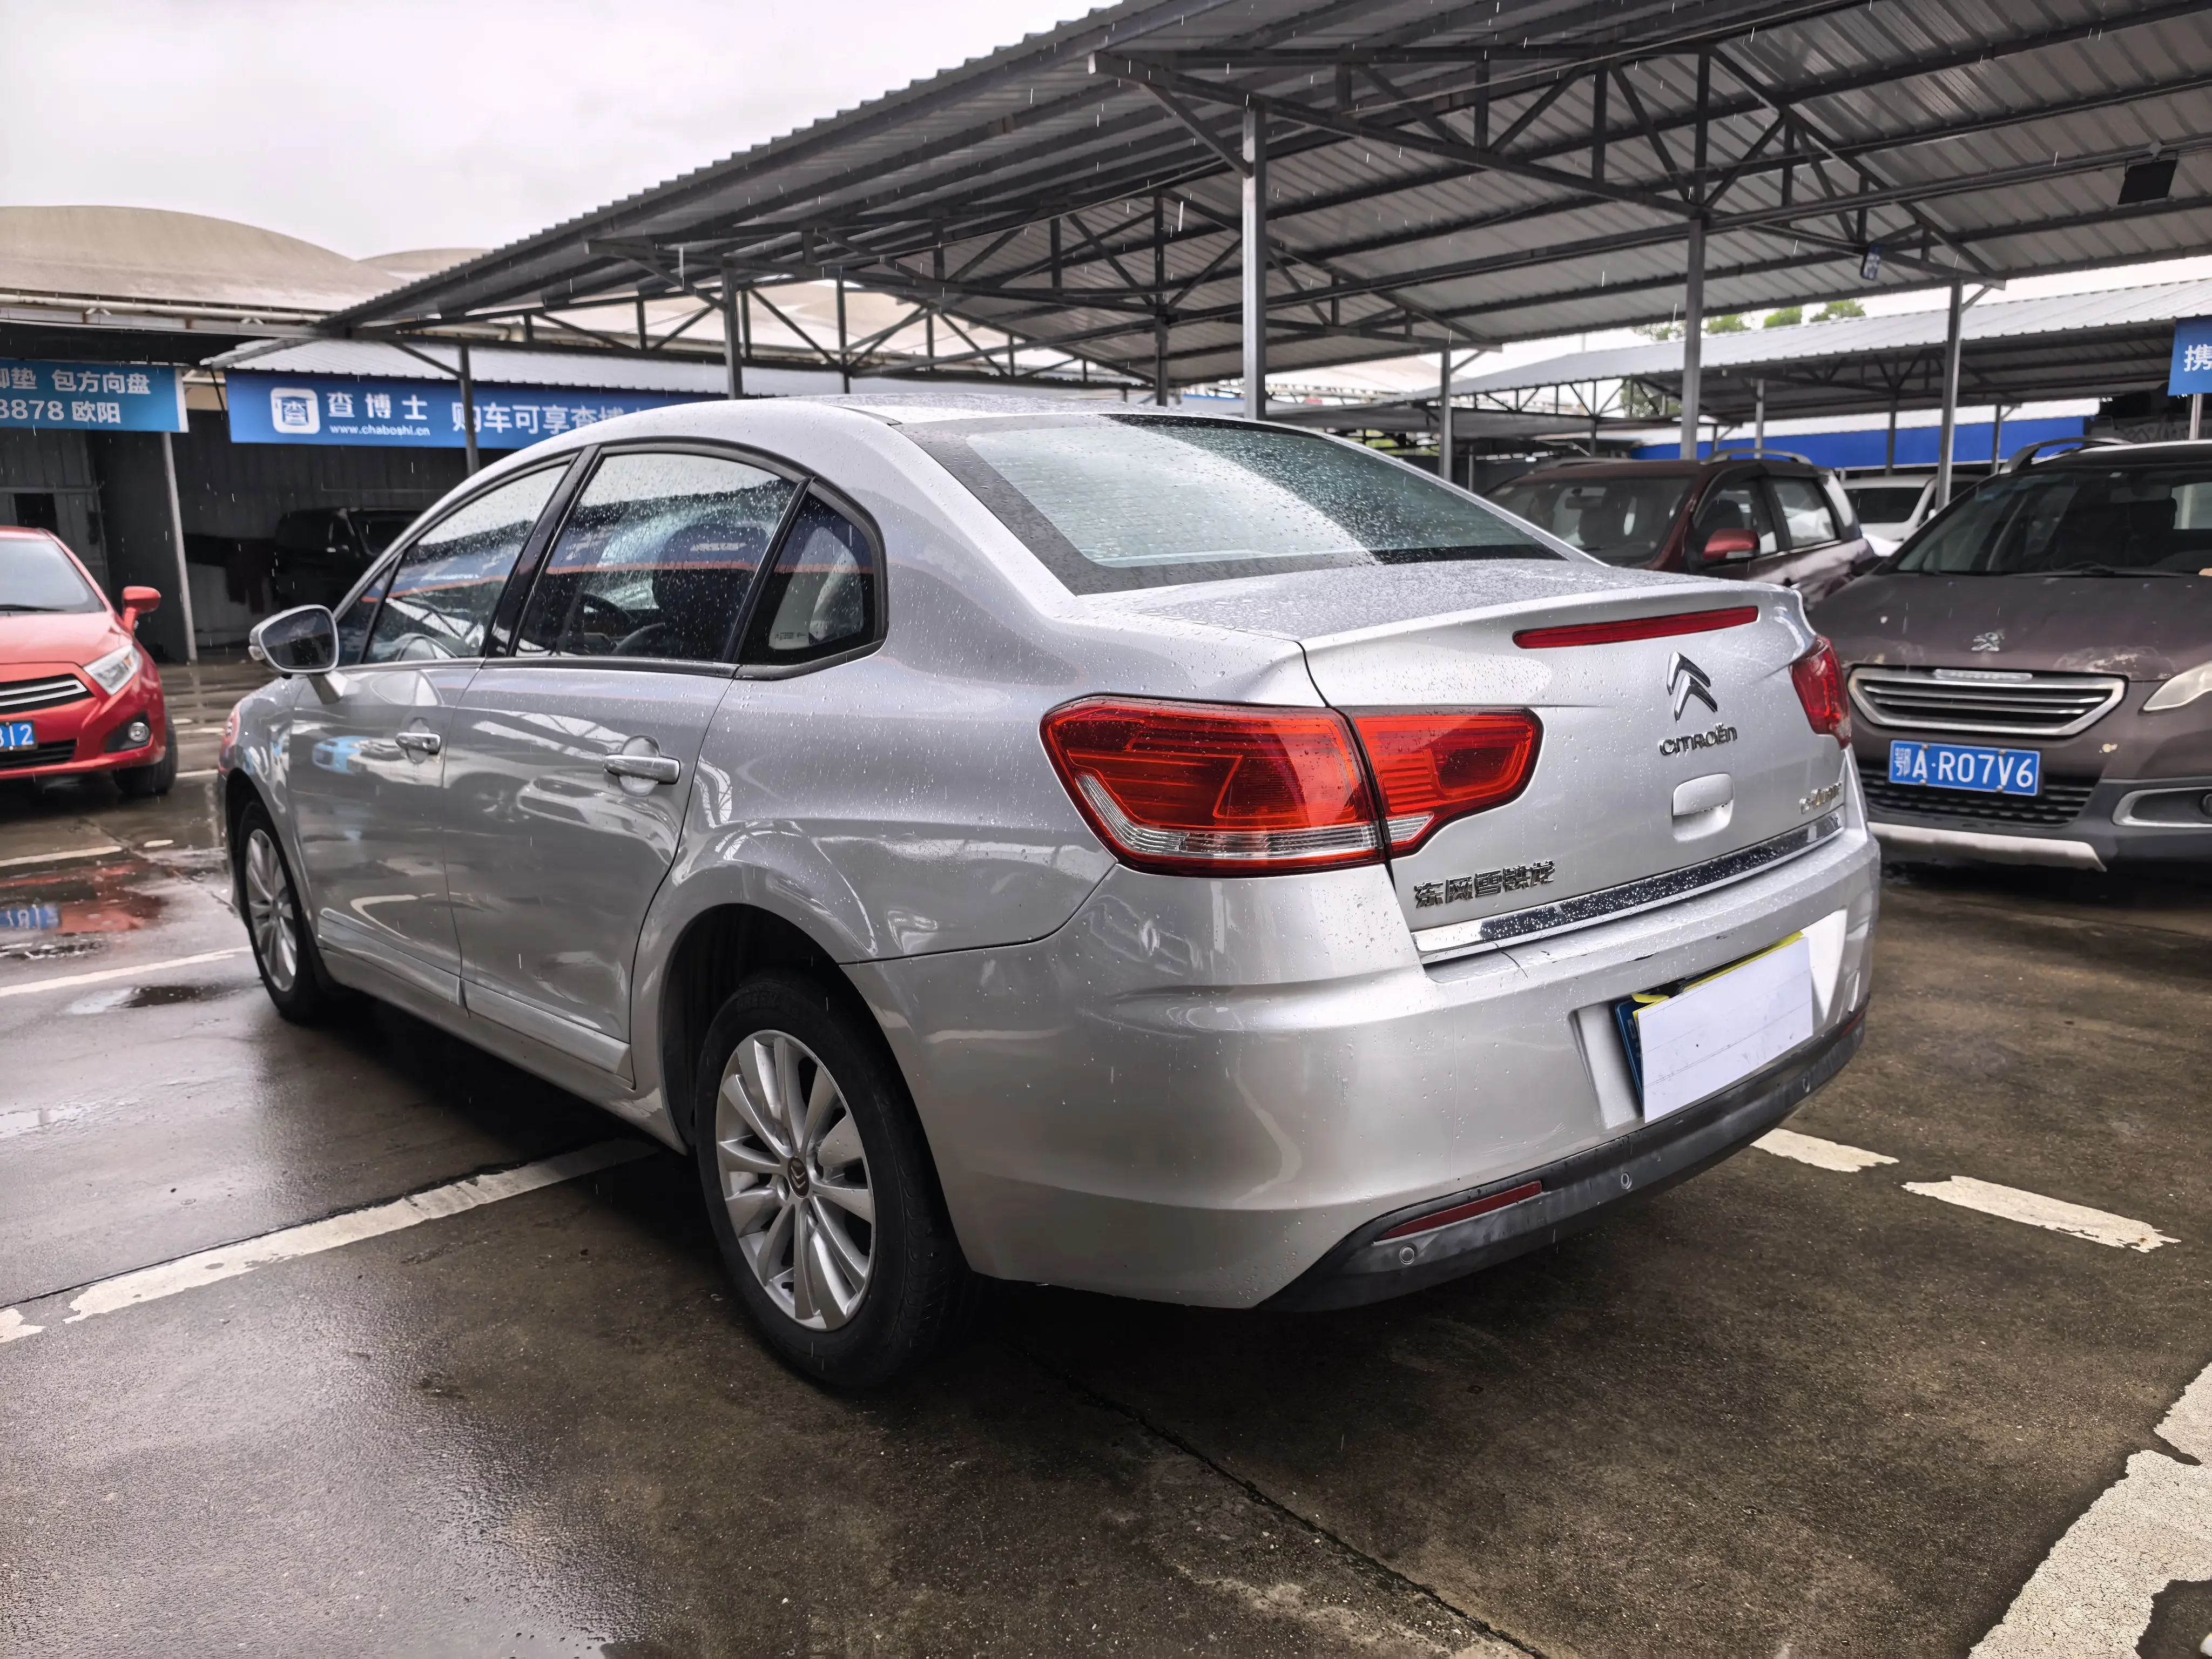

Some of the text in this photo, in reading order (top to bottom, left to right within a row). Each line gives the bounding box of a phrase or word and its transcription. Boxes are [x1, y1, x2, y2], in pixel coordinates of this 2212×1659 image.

[52, 369, 151, 394] 包方向盘
[71, 401, 121, 423] 欧阳
[327, 392, 428, 420] 查博士
[451, 401, 641, 434] 购车可享查
[329, 424, 430, 436] www.chaboshi.cn
[1414, 860, 1555, 908] 东风雪铁龙
